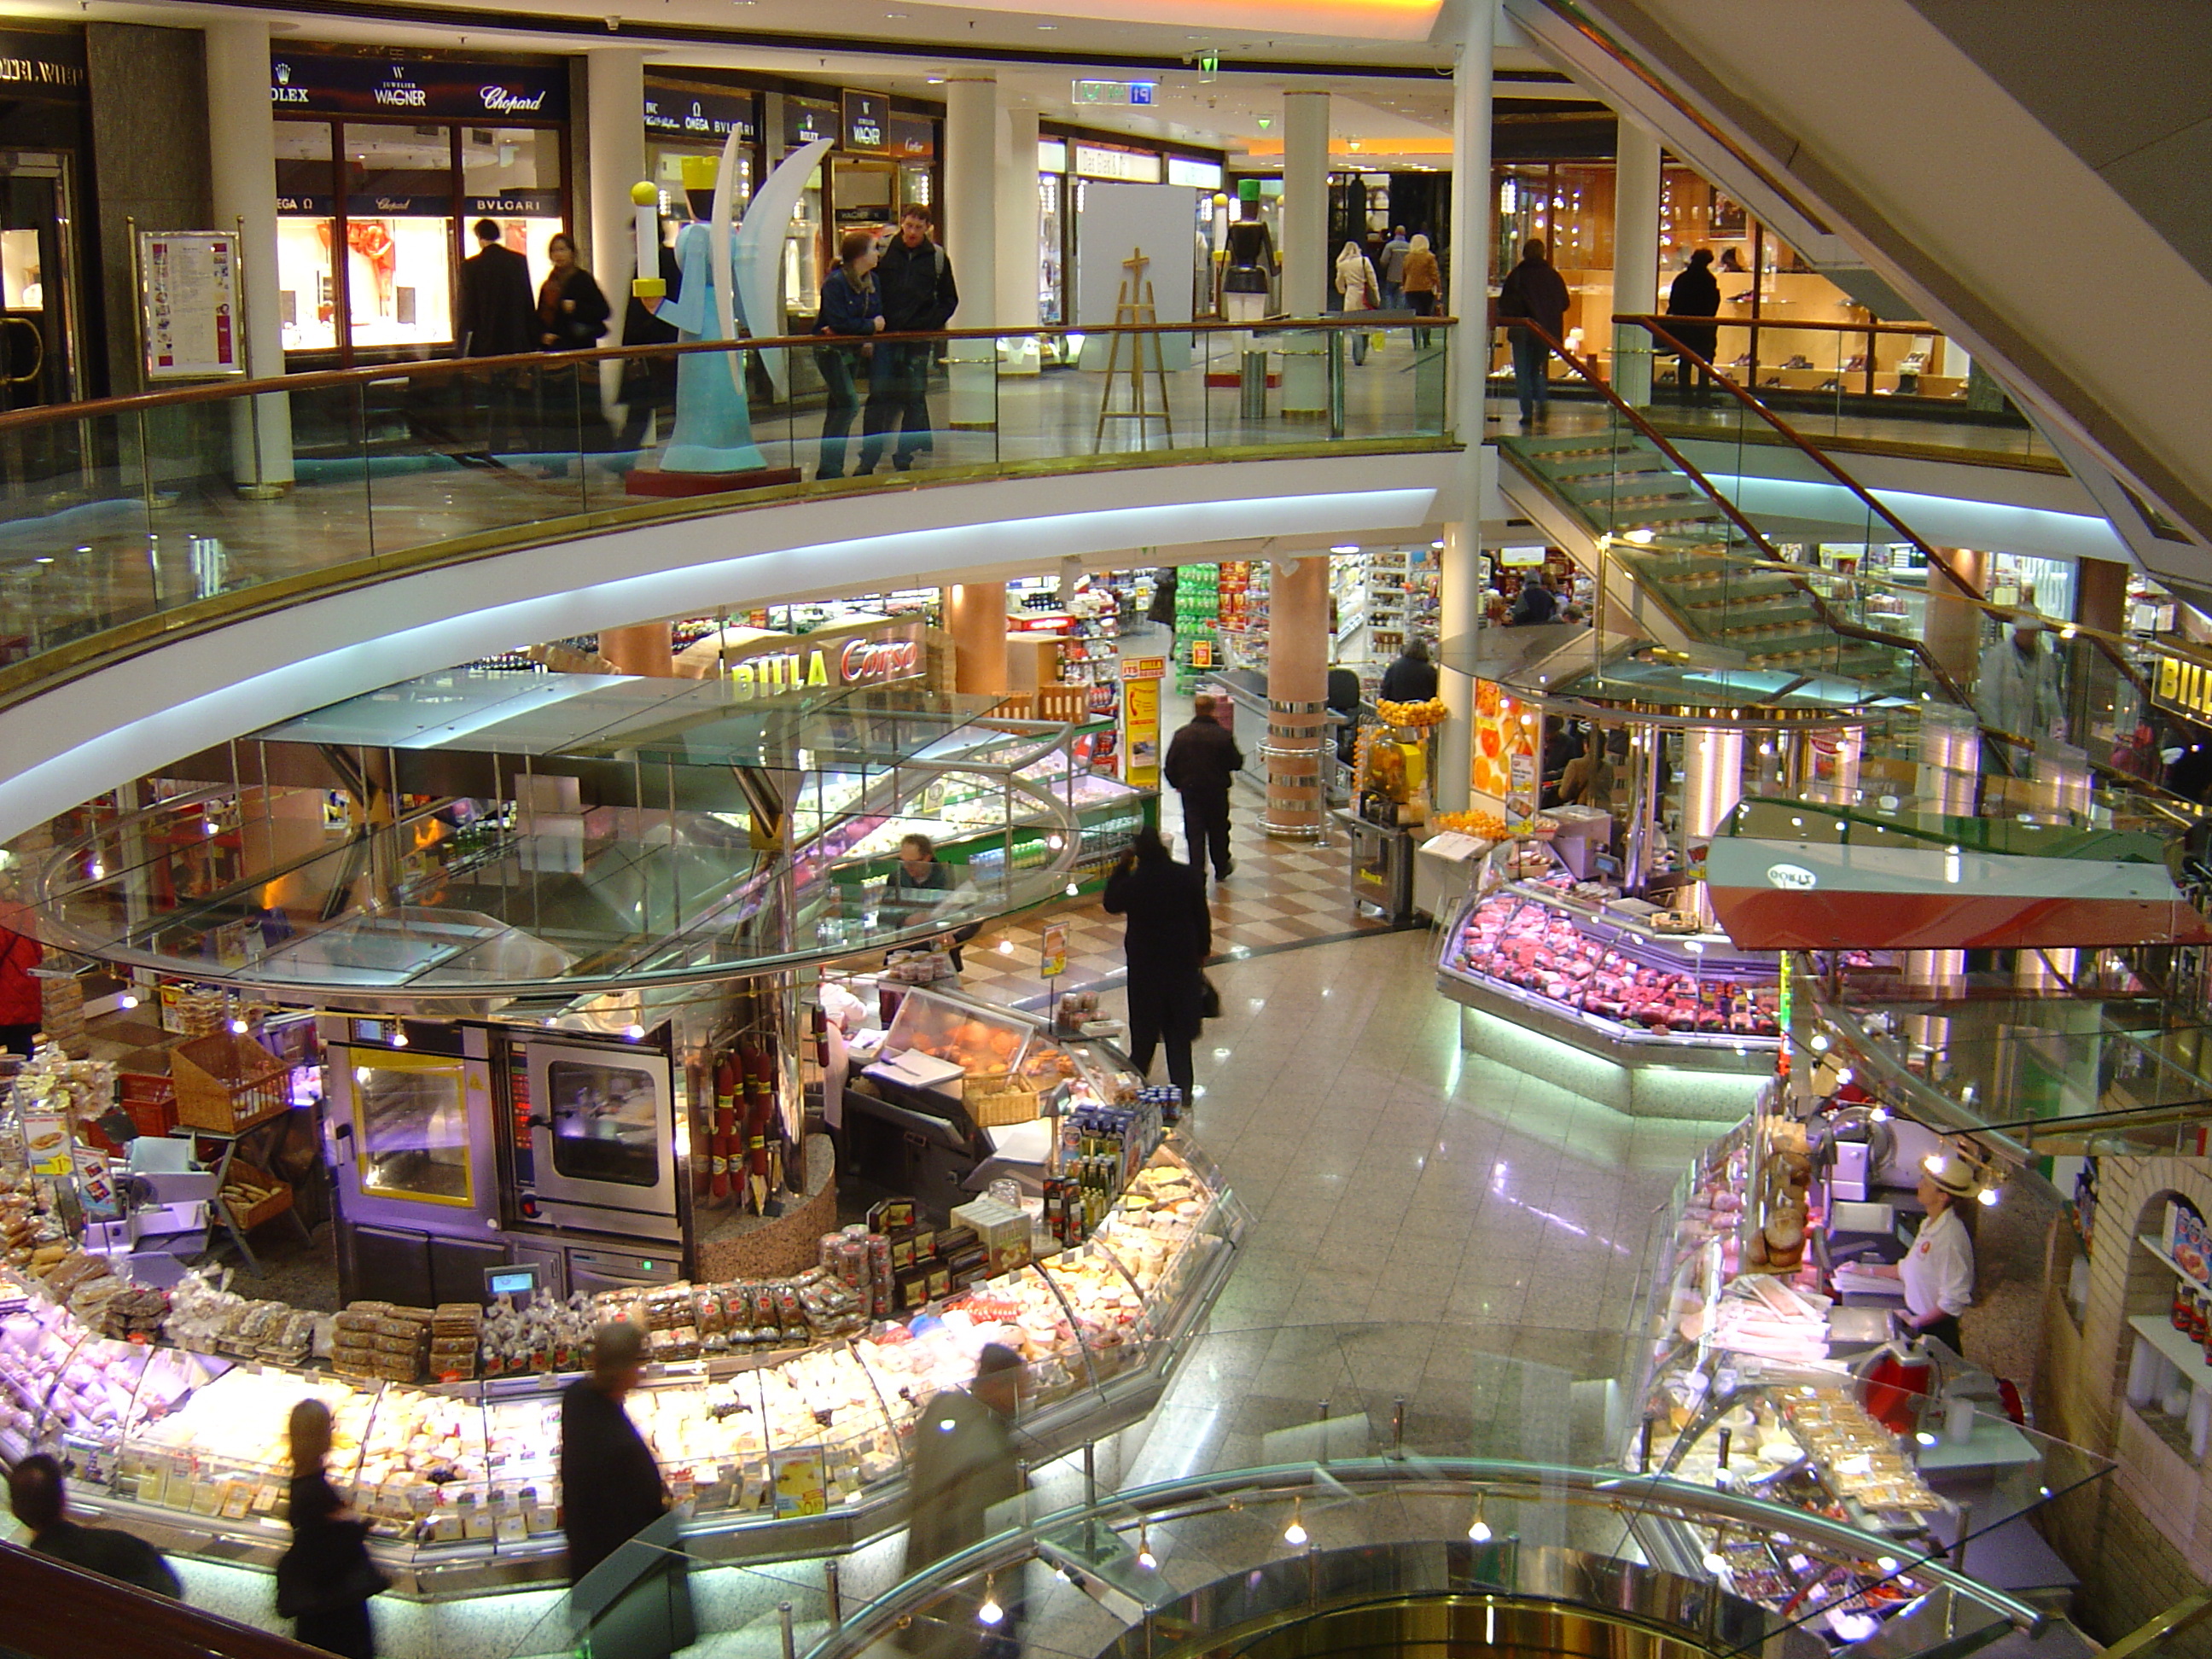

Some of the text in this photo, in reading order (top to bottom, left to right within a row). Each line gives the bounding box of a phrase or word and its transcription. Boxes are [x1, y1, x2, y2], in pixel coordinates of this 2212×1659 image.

[0, 57, 38, 82] TEL
[271, 88, 310, 102] OLEX
[375, 89, 427, 107] WAGNER
[480, 86, 546, 114] Chopard
[685, 116, 710, 131] OMEGA
[853, 125, 881, 145] WAGNER
[276, 197, 299, 210] EGA
[476, 200, 541, 211] BVLGARI
[731, 637, 917, 701] BILLA Corso
